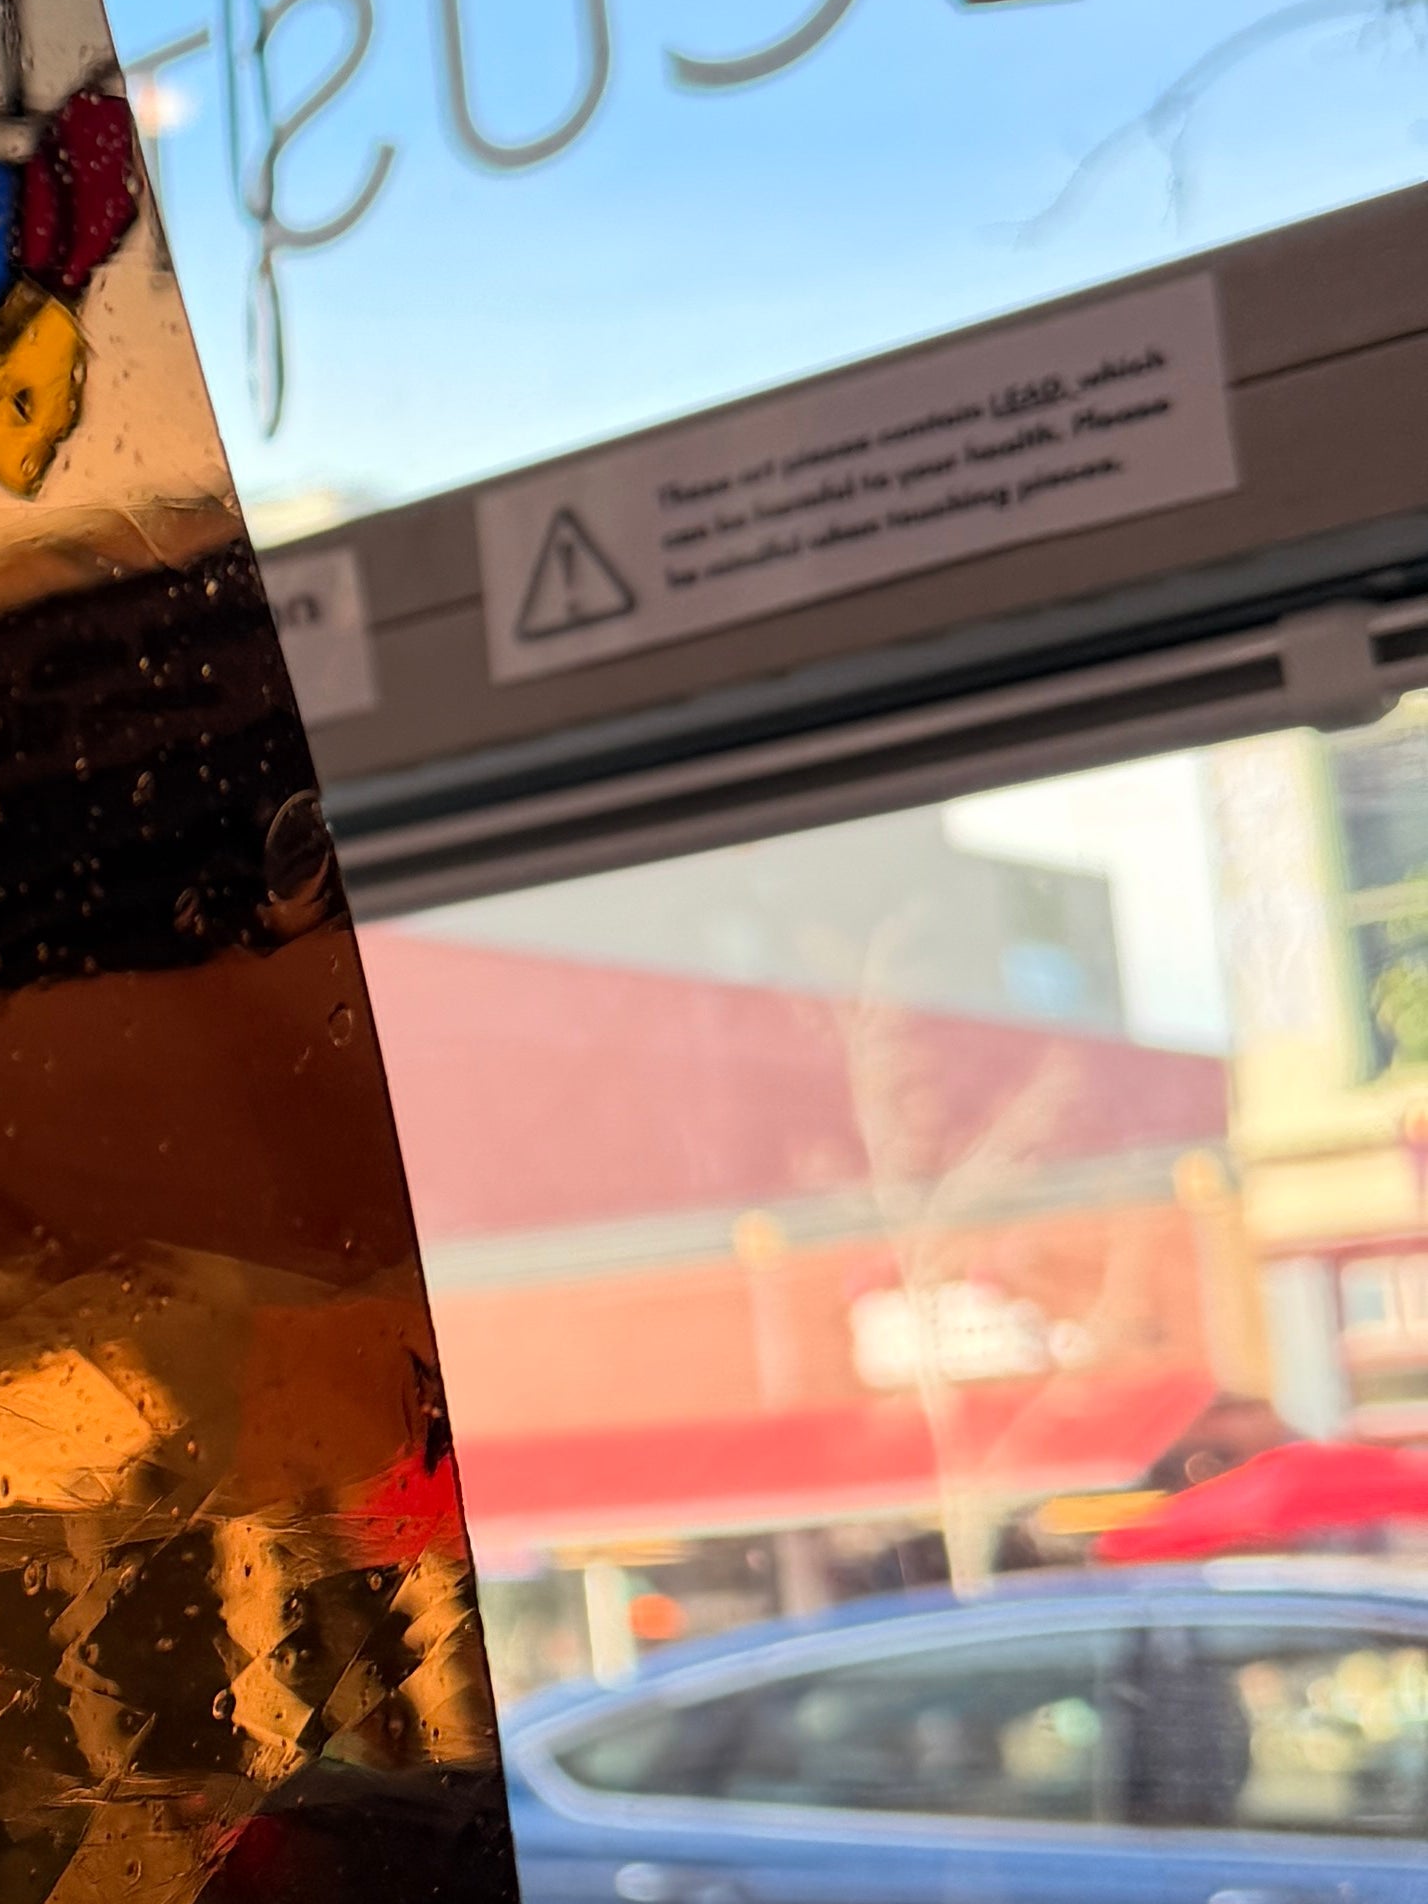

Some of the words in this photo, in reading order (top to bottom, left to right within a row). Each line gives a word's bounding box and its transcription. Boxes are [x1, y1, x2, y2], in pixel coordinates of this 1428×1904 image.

[662, 526, 709, 550] can
[713, 512, 747, 534] be
[752, 475, 856, 519] harmful
[861, 473, 890, 494] to
[896, 455, 957, 492] your
[964, 422, 1063, 463] health.
[1071, 395, 1173, 439] Please
[781, 438, 872, 479] pieces
[876, 405, 983, 446] contain
[1077, 349, 1166, 391] which
[665, 564, 699, 590] be
[703, 535, 801, 579] mindful
[808, 517, 882, 550] when
[885, 486, 1010, 530] touching
[1015, 455, 1125, 505] pieces.
